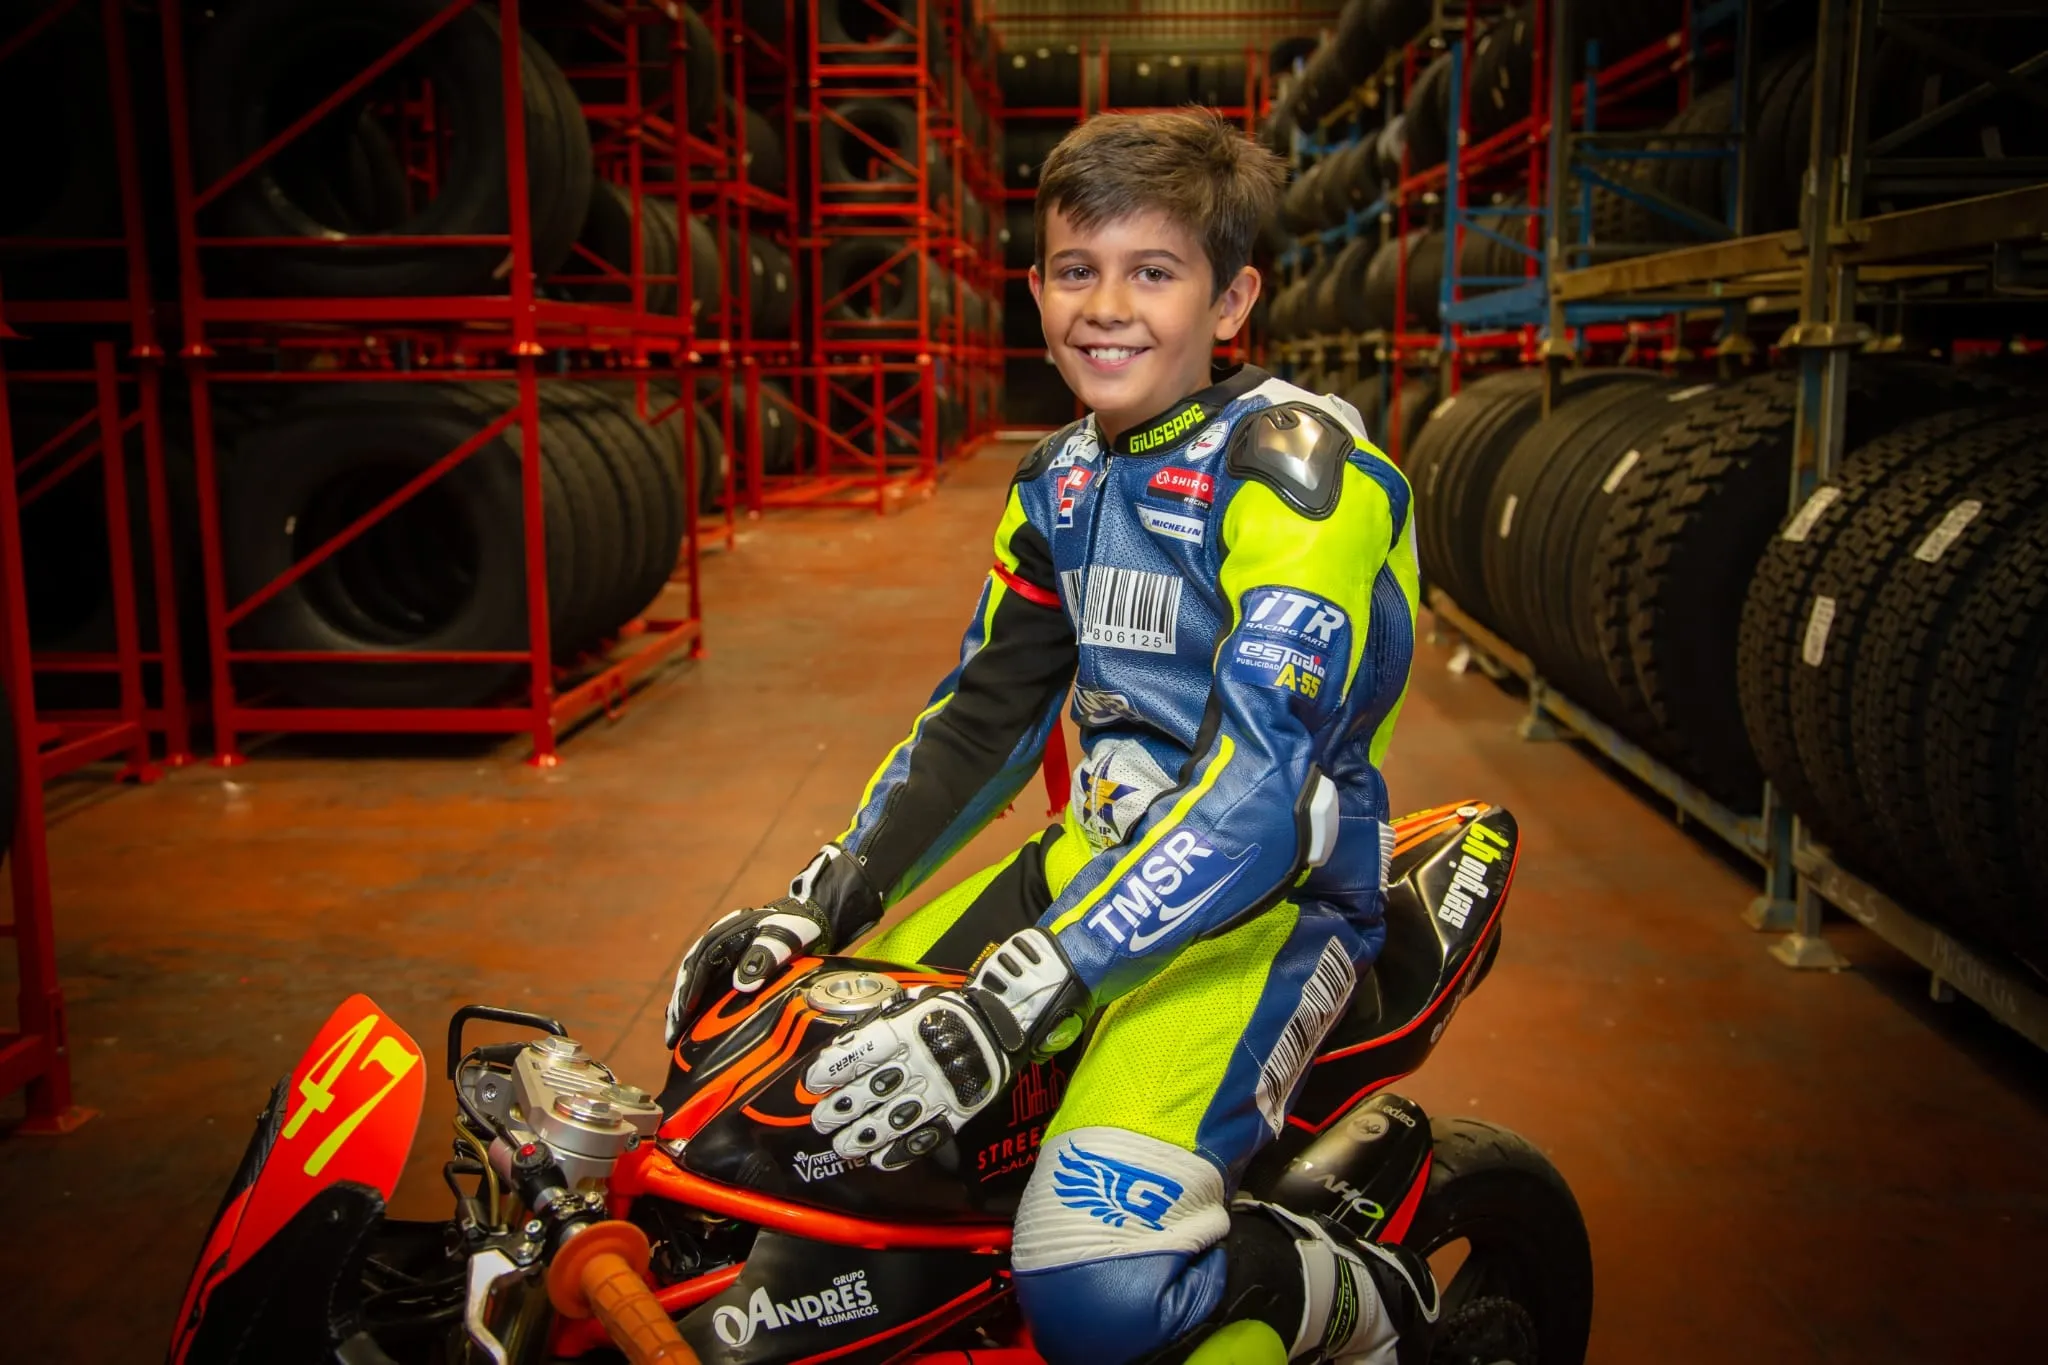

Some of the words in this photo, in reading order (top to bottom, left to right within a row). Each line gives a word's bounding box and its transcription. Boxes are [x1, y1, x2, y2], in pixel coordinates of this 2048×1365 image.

[1171, 475, 1210, 492] SHIRO
[1151, 519, 1201, 537] MICHELIN
[1246, 622, 1299, 636] RACING
[1299, 633, 1329, 649] PARTS
[1236, 657, 1281, 672] PUBLICIDAD
[1273, 663, 1322, 699] A-55
[1087, 830, 1213, 943] TMSR
[283, 1014, 420, 1178] 47
[1382, 1105, 1417, 1129] carpe
[977, 1122, 1050, 1171] STREE
[792, 1150, 839, 1183] VIVER
[833, 1269, 866, 1287] GRUPO
[748, 1280, 873, 1331] ANDRES
[817, 1304, 879, 1328] NEUMATICOS
